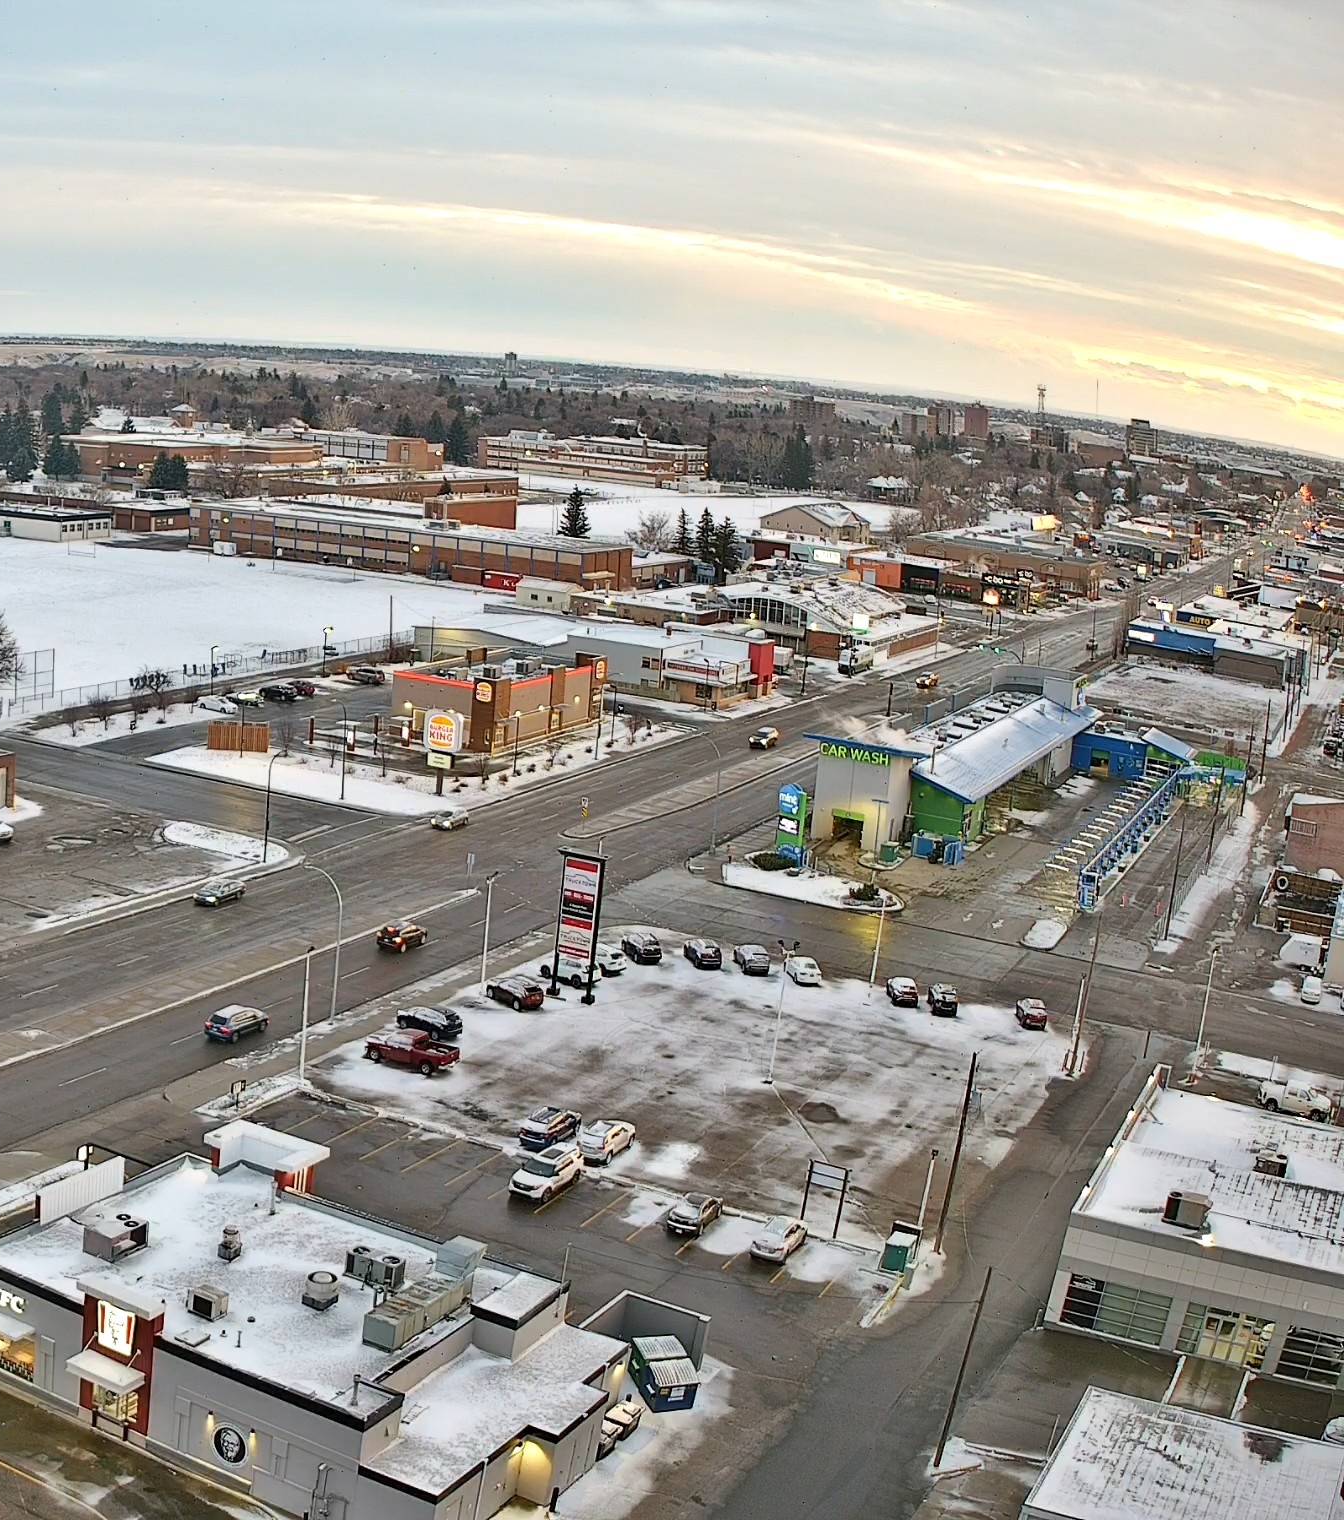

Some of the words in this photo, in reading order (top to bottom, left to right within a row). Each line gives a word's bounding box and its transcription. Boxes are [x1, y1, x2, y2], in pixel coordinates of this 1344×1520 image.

[1189, 615, 1211, 626] AUTO
[429, 724, 453, 733] BURGER
[429, 730, 453, 742] KING
[820, 742, 847, 759] CAR
[850, 747, 889, 767] WASH
[779, 791, 798, 805] mint
